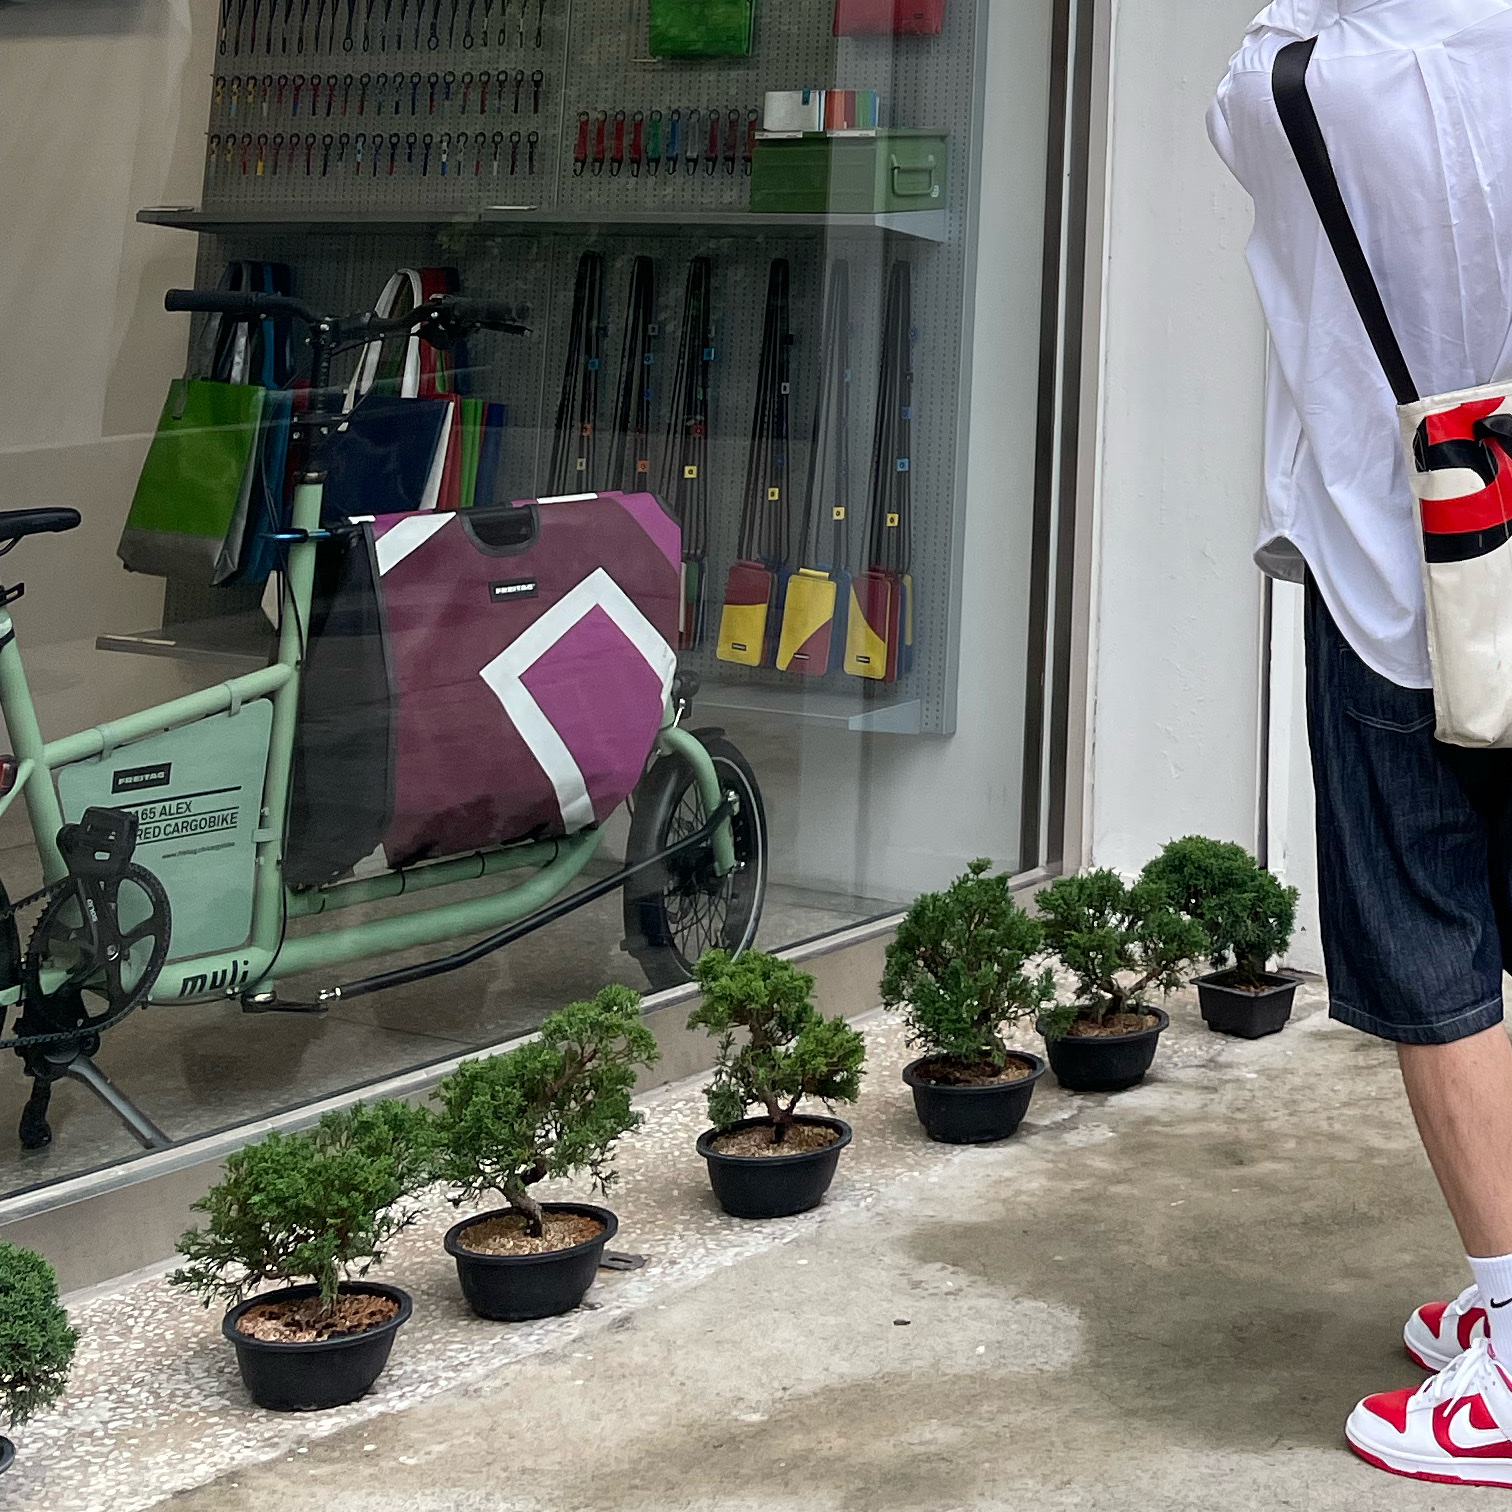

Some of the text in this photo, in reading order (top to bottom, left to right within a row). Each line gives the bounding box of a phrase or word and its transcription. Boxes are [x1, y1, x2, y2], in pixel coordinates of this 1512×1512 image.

[118, 771, 165, 786] FREITAG
[158, 800, 193, 818] ALEX
[163, 811, 239, 837] CARGOBIKE
[179, 959, 250, 998] muli
